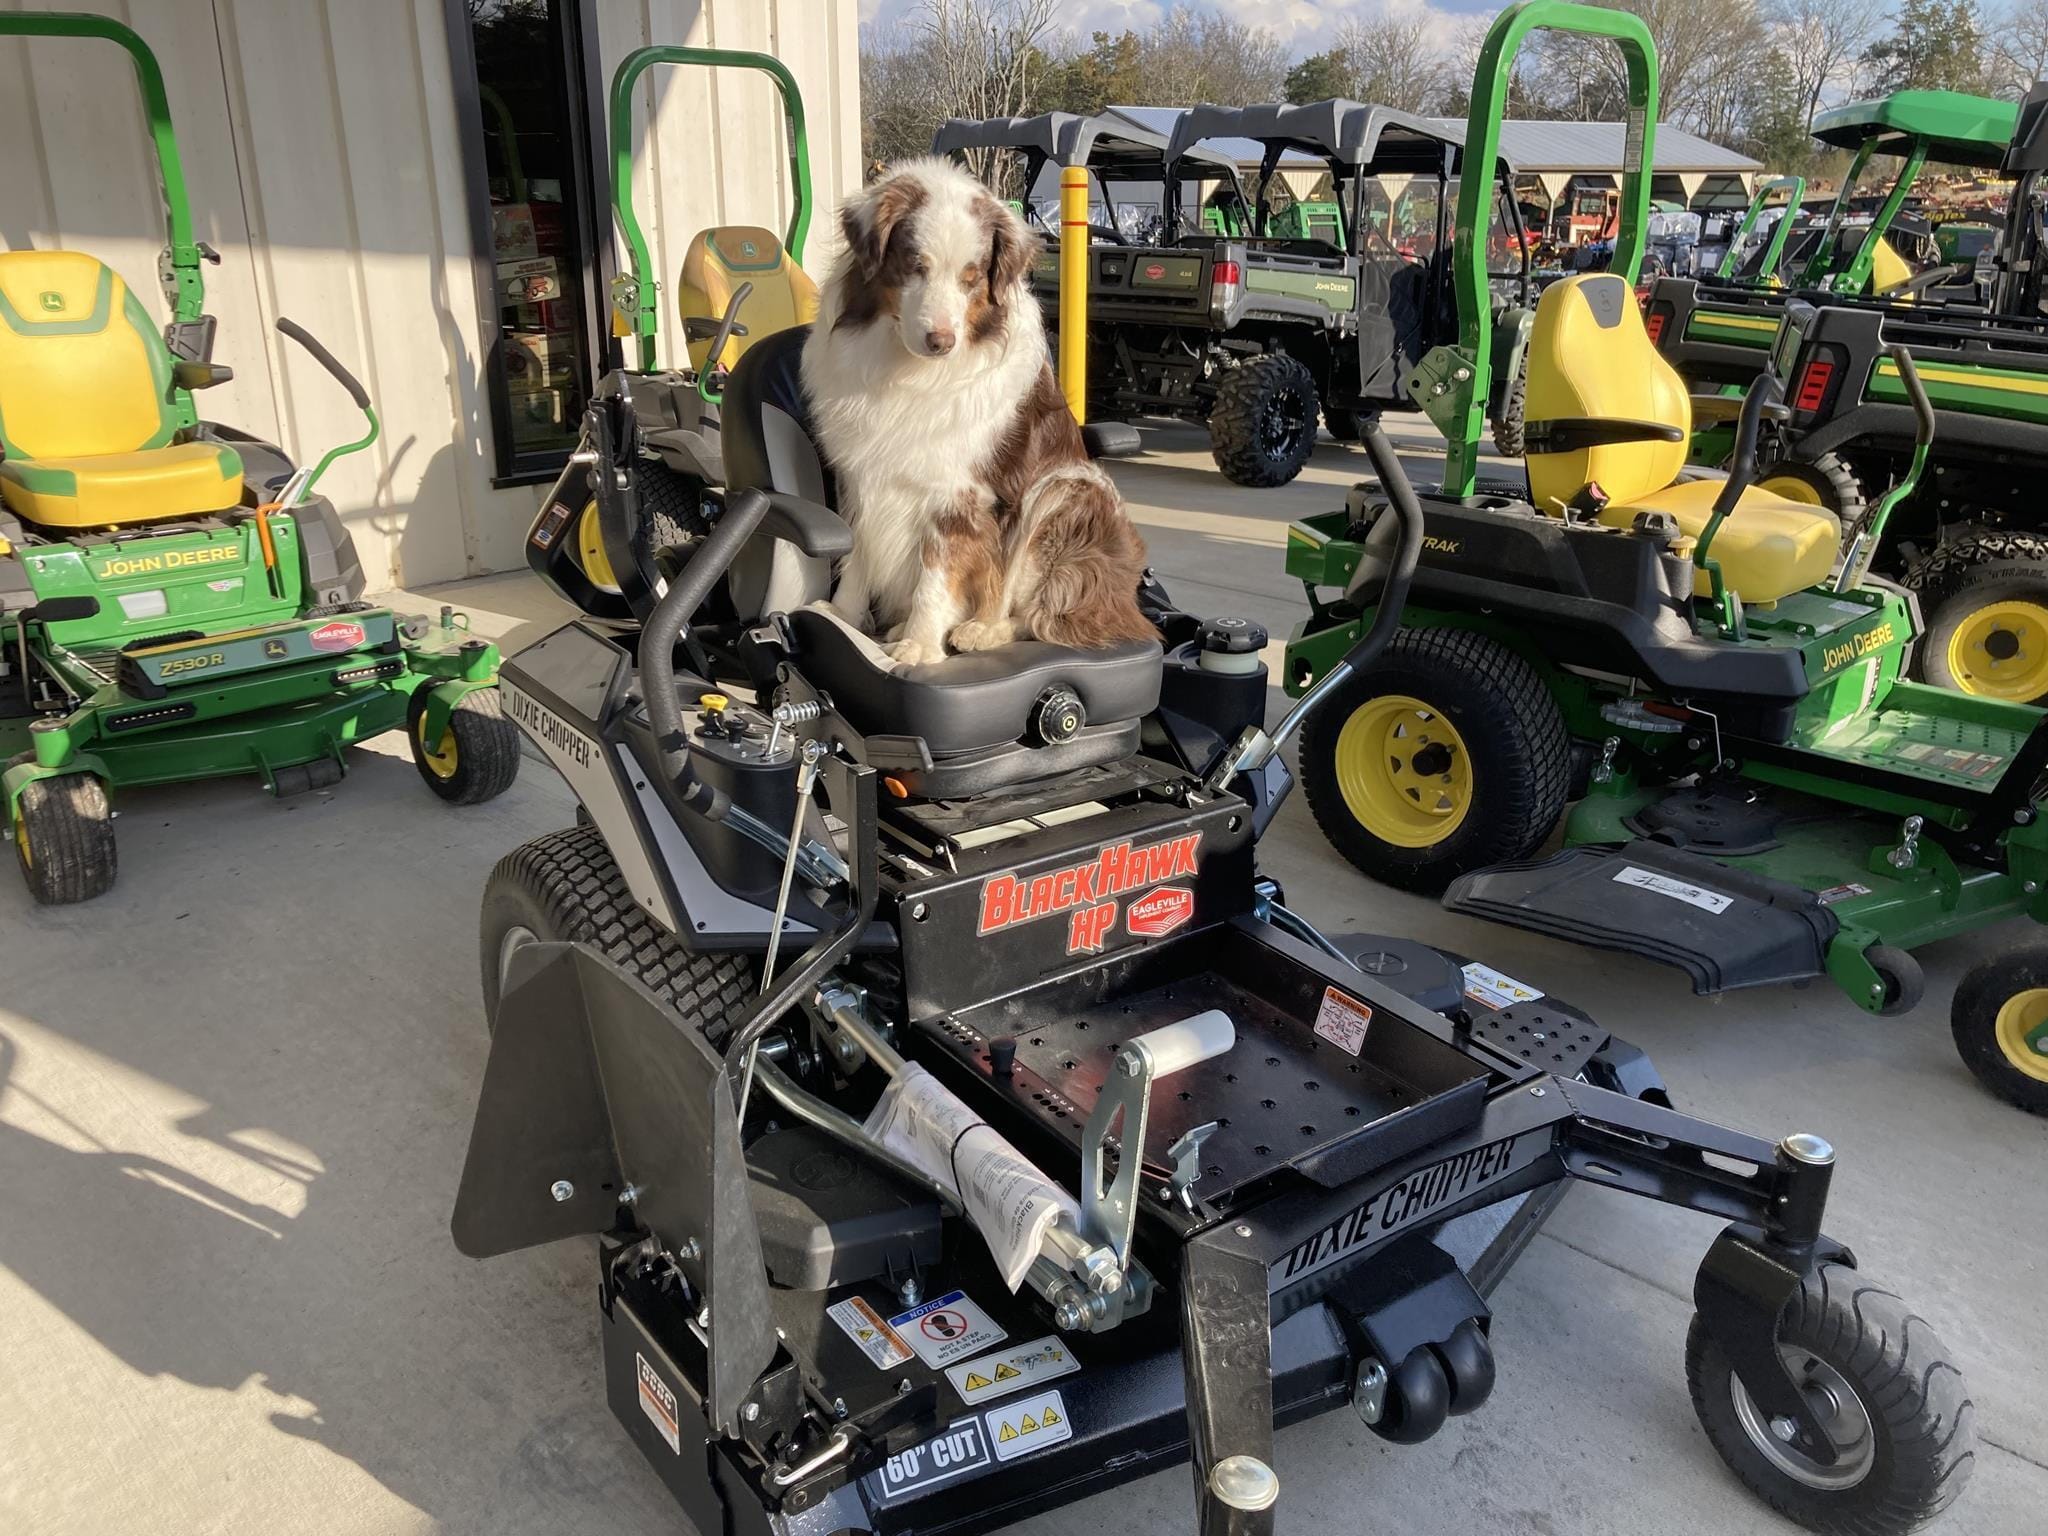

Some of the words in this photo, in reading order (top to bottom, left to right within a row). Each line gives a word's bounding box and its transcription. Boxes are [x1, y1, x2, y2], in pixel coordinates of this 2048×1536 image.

[1315, 282, 1330, 290] JOHN
[1331, 282, 1348, 292] DEERE
[1422, 536, 1459, 553] TRAK
[100, 555, 162, 578] JOHN
[165, 545, 239, 567] DEERE
[1823, 640, 1854, 673] JOHN
[1854, 622, 1894, 657] DEERE
[159, 655, 209, 678] Z530
[210, 653, 225, 665] R
[512, 690, 540, 732] DIXIE
[541, 711, 590, 769] CHOPPER
[1132, 893, 1187, 916] EAGLEVILLE
[1068, 901, 1117, 952] HP
[1337, 995, 1367, 1016] WARNING
[1284, 1196, 1380, 1279] DIXIE
[1380, 1136, 1517, 1230] CHOPPER
[909, 1299, 946, 1319] NOTICE
[937, 1351, 949, 1359] NO
[971, 1332, 991, 1344] PASO
[939, 1342, 955, 1352] NOT
[961, 1331, 979, 1342] STEP
[933, 1429, 977, 1468] CUT
